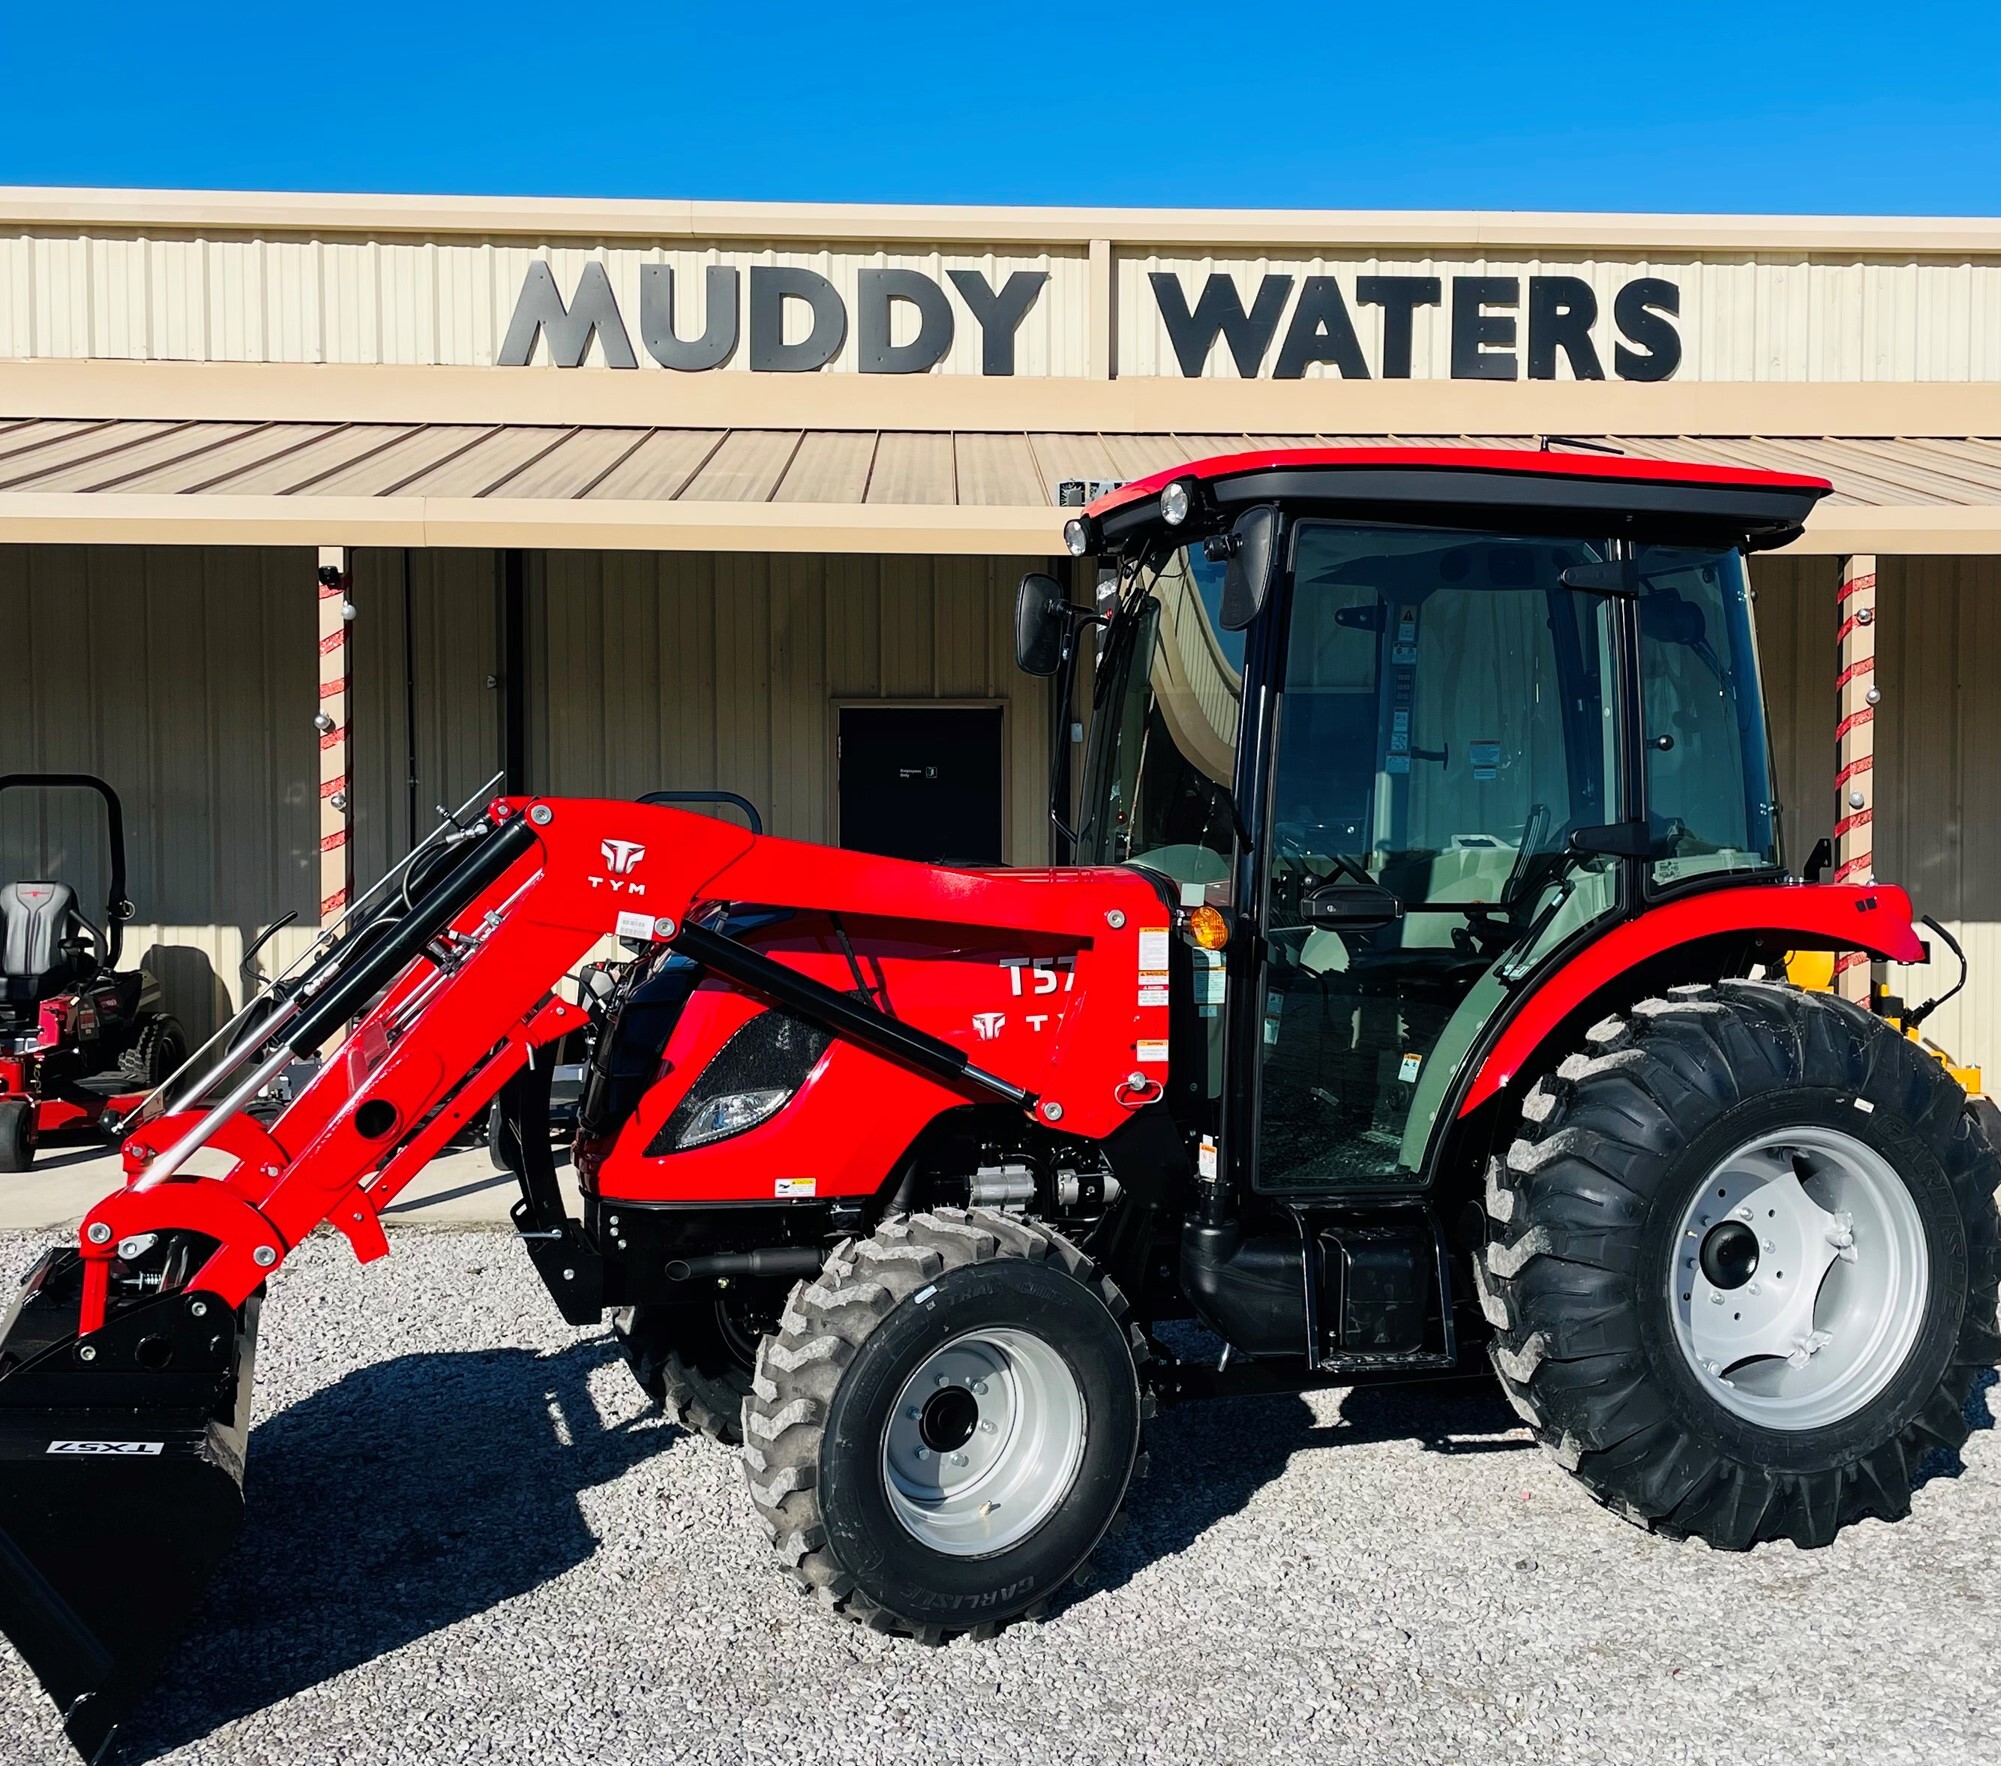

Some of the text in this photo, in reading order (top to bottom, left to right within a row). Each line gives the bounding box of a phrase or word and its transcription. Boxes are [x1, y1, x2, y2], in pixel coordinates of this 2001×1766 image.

[498, 261, 1681, 381] MUDDY WATERS
[588, 876, 645, 895] TYM
[999, 956, 1077, 996] T57
[54, 1442, 154, 1453] TX57
[900, 1575, 1035, 1610] CARLISLE
